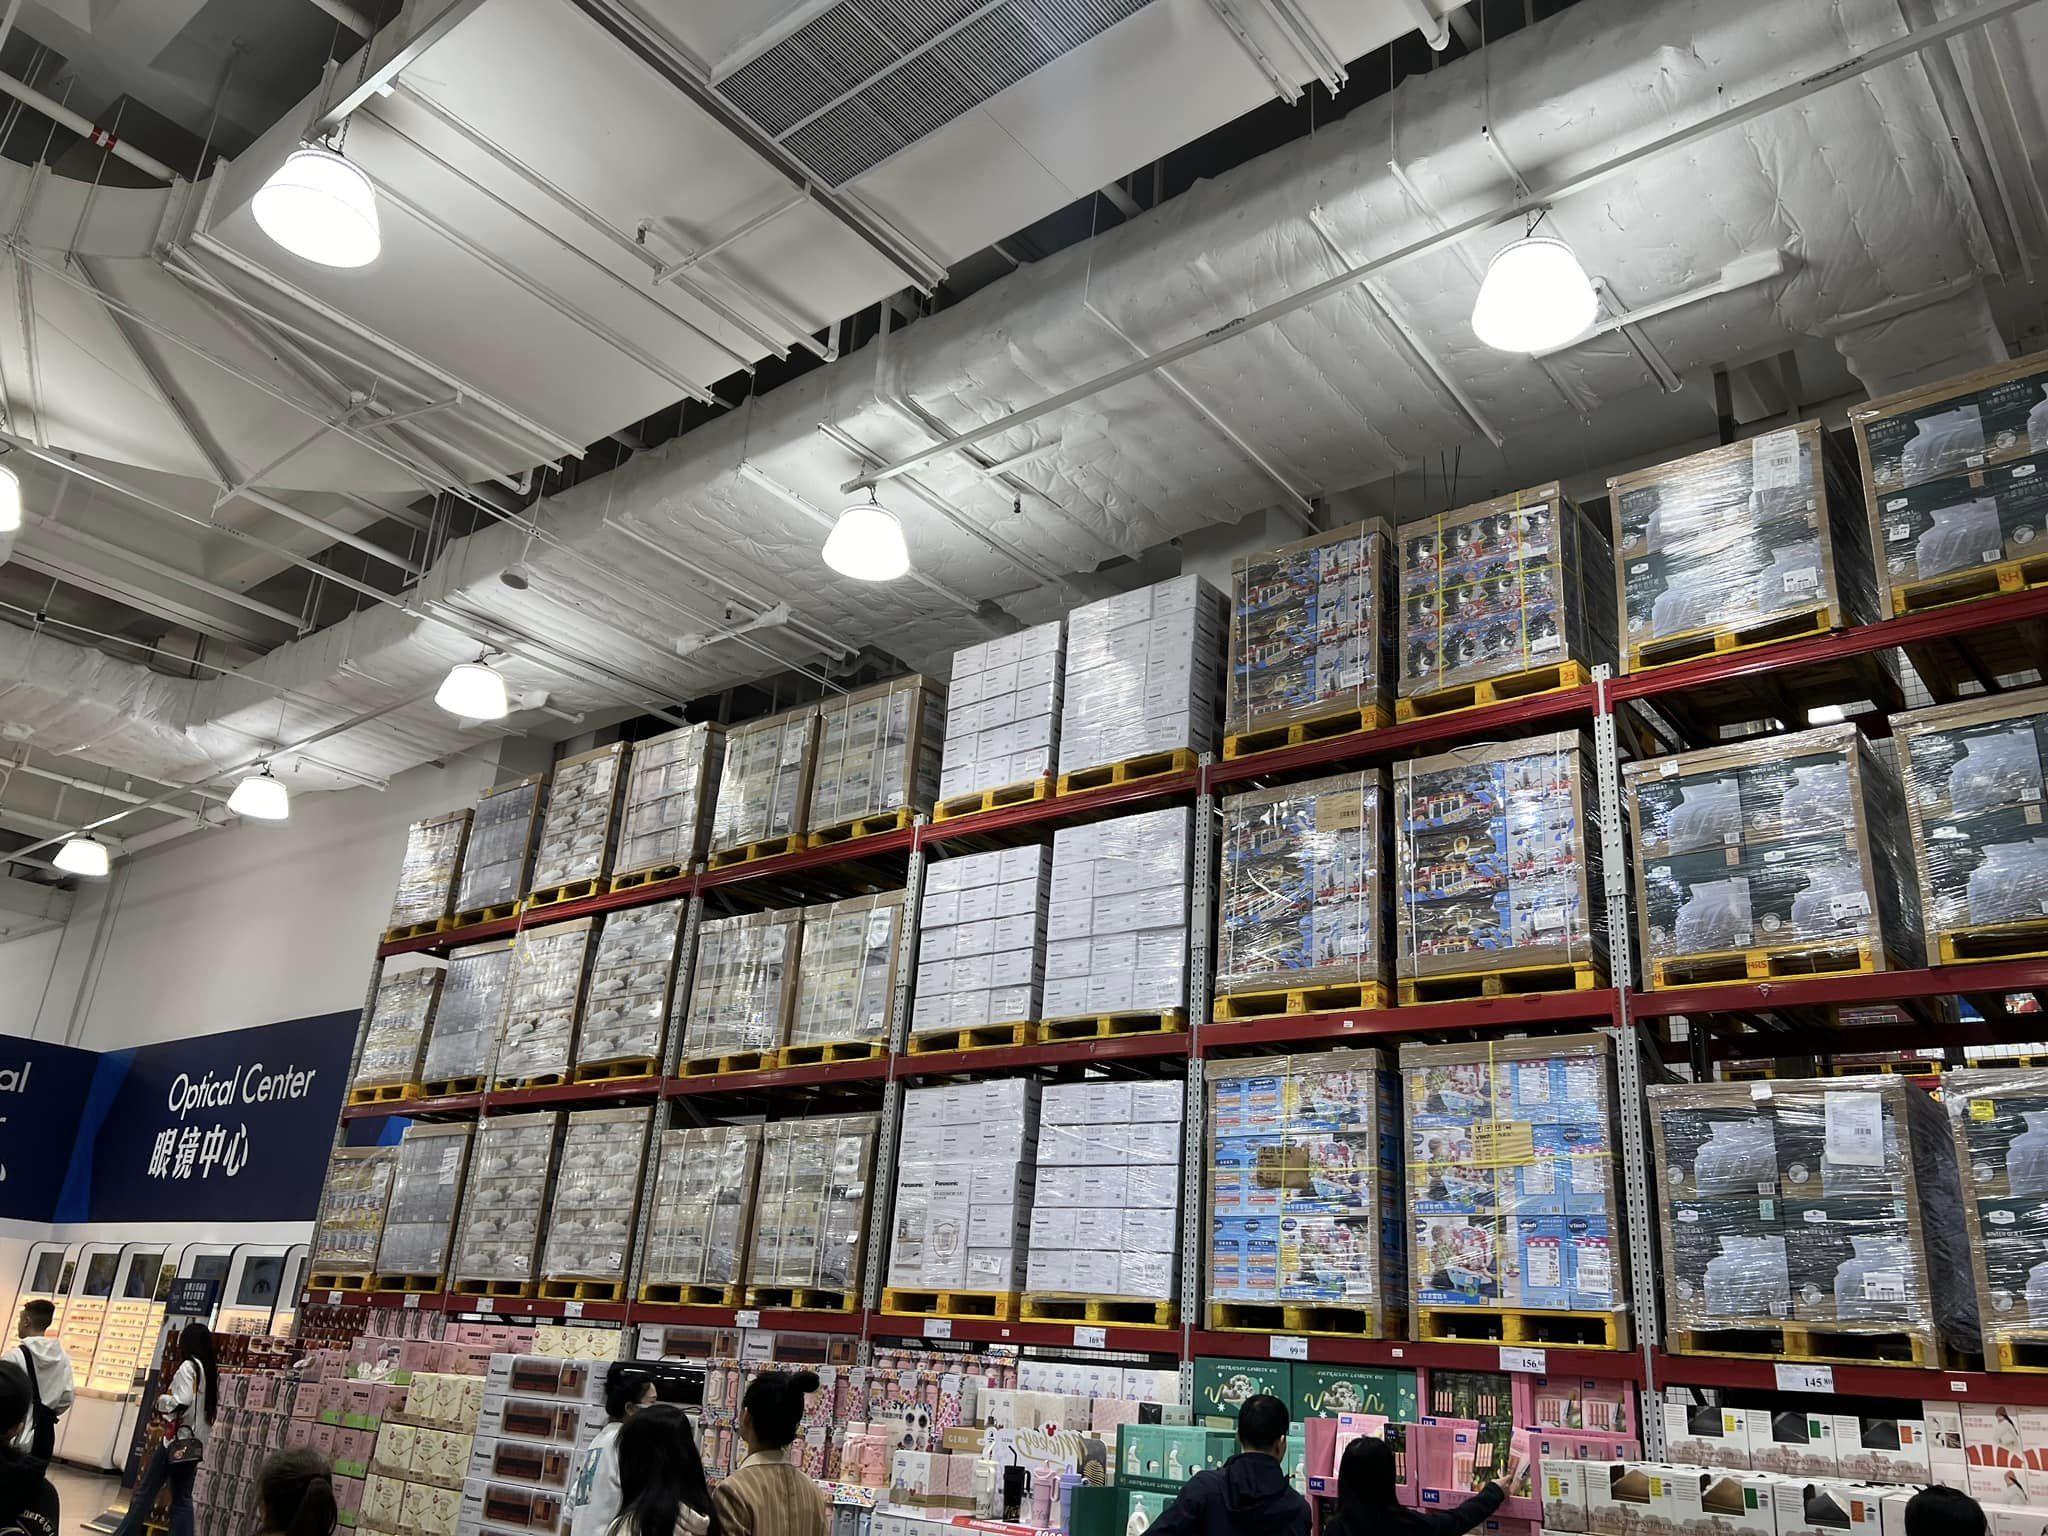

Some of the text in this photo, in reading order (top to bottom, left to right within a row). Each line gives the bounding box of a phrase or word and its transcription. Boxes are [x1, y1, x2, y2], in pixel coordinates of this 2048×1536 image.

[168, 1063, 316, 1121] Optical Center
[147, 1123, 249, 1180] 眼镜中心
